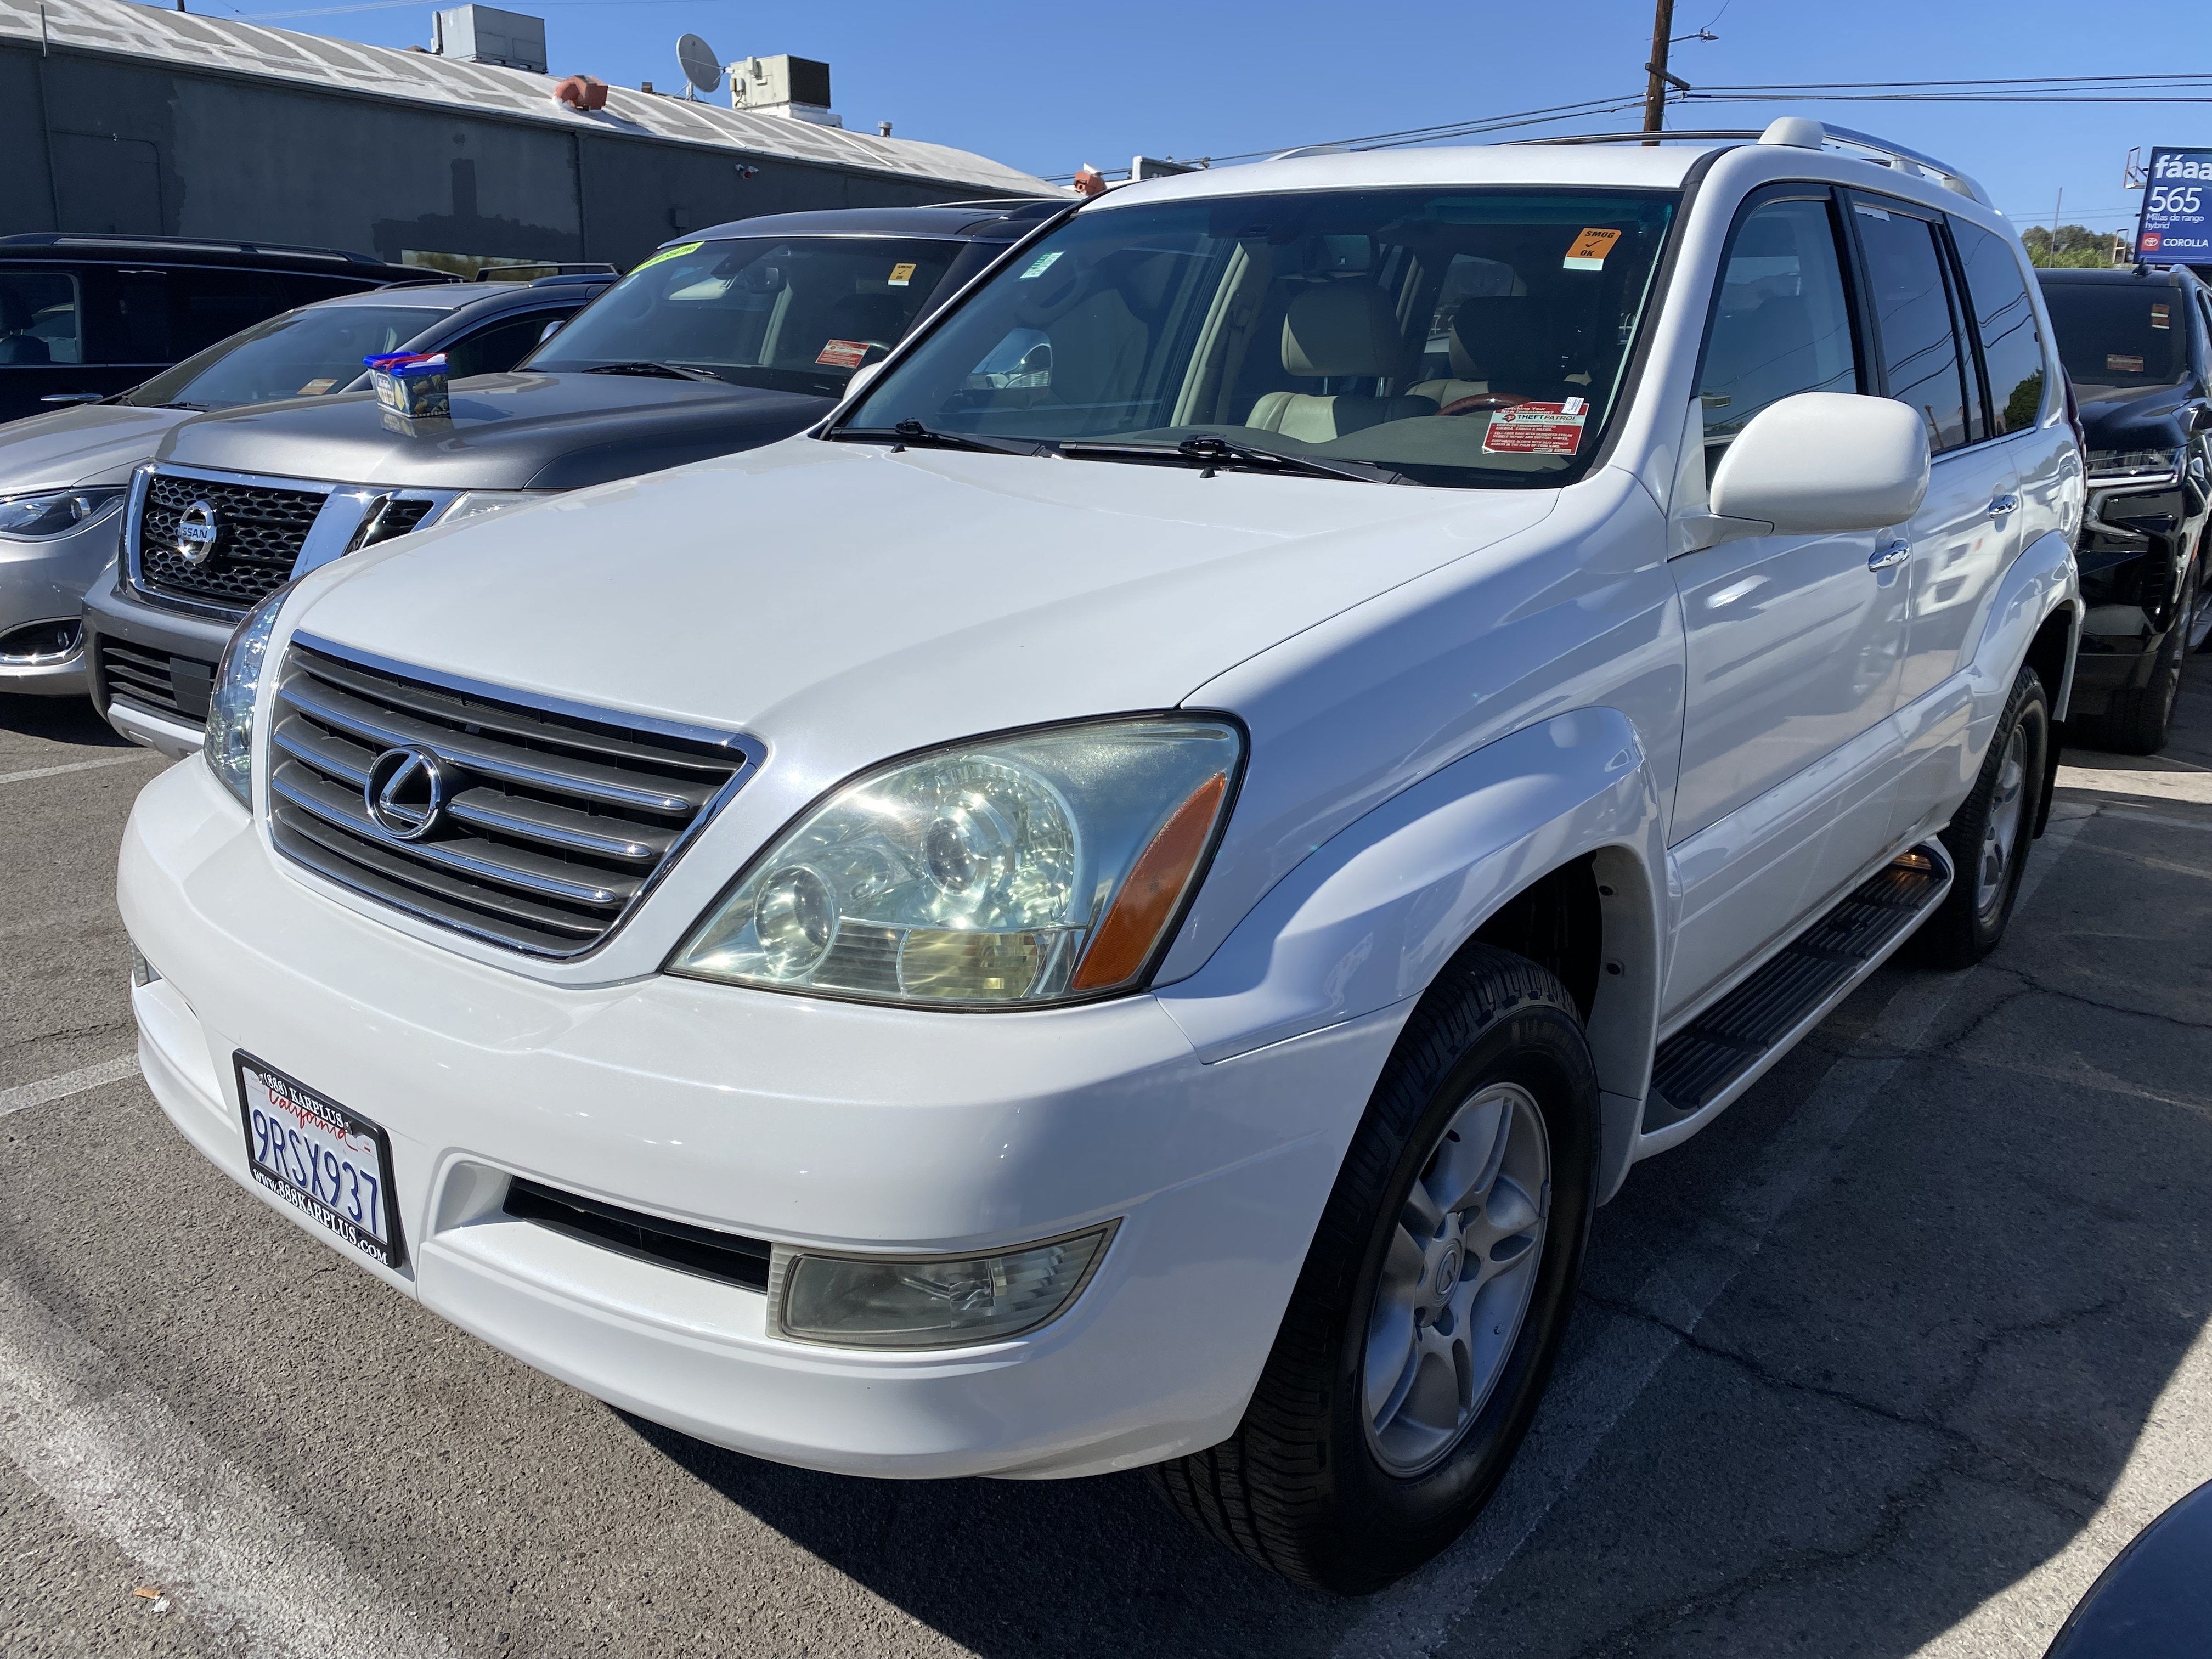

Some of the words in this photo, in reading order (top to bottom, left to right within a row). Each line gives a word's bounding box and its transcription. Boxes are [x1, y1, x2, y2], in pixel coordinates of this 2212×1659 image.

[2148, 187, 2202, 213] 565
[2145, 222, 2170, 230] hybrid
[2163, 238, 2209, 247] COROLLA
[181, 527, 208, 538] SSAN
[264, 1072, 288, 1097] (888)
[289, 1087, 344, 1128] KARPLUS
[253, 1109, 377, 1234] 9RSX937
